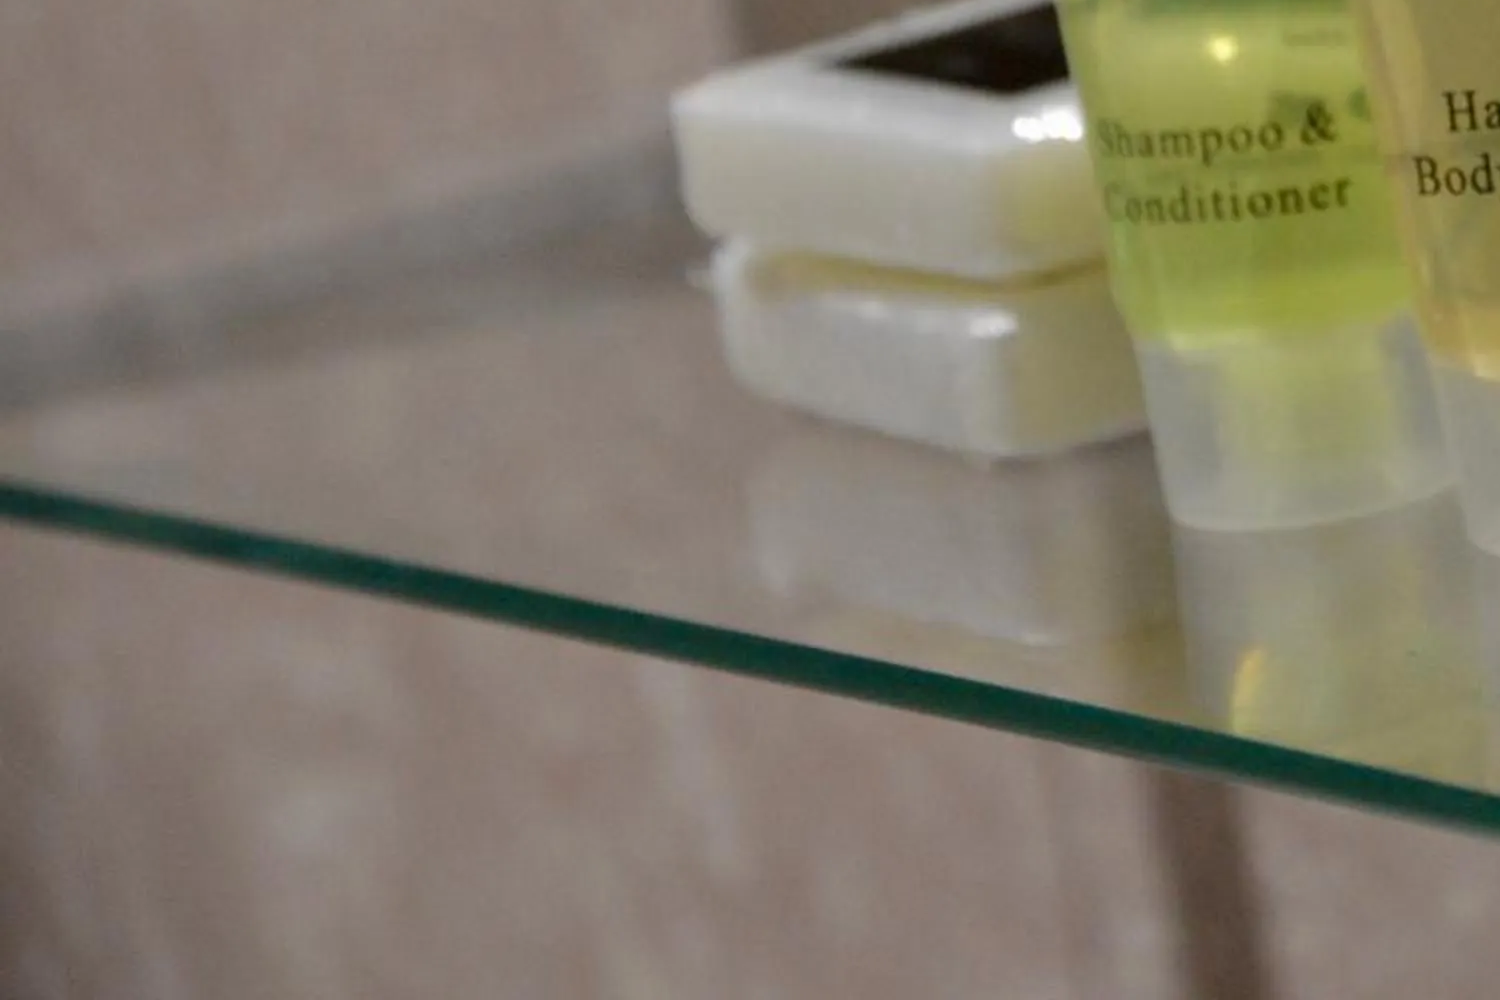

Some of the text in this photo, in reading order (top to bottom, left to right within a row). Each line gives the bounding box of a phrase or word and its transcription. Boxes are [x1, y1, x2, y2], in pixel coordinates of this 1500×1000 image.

[1097, 98, 1338, 168] Shampoo &
[1103, 175, 1353, 225] Conditioner
